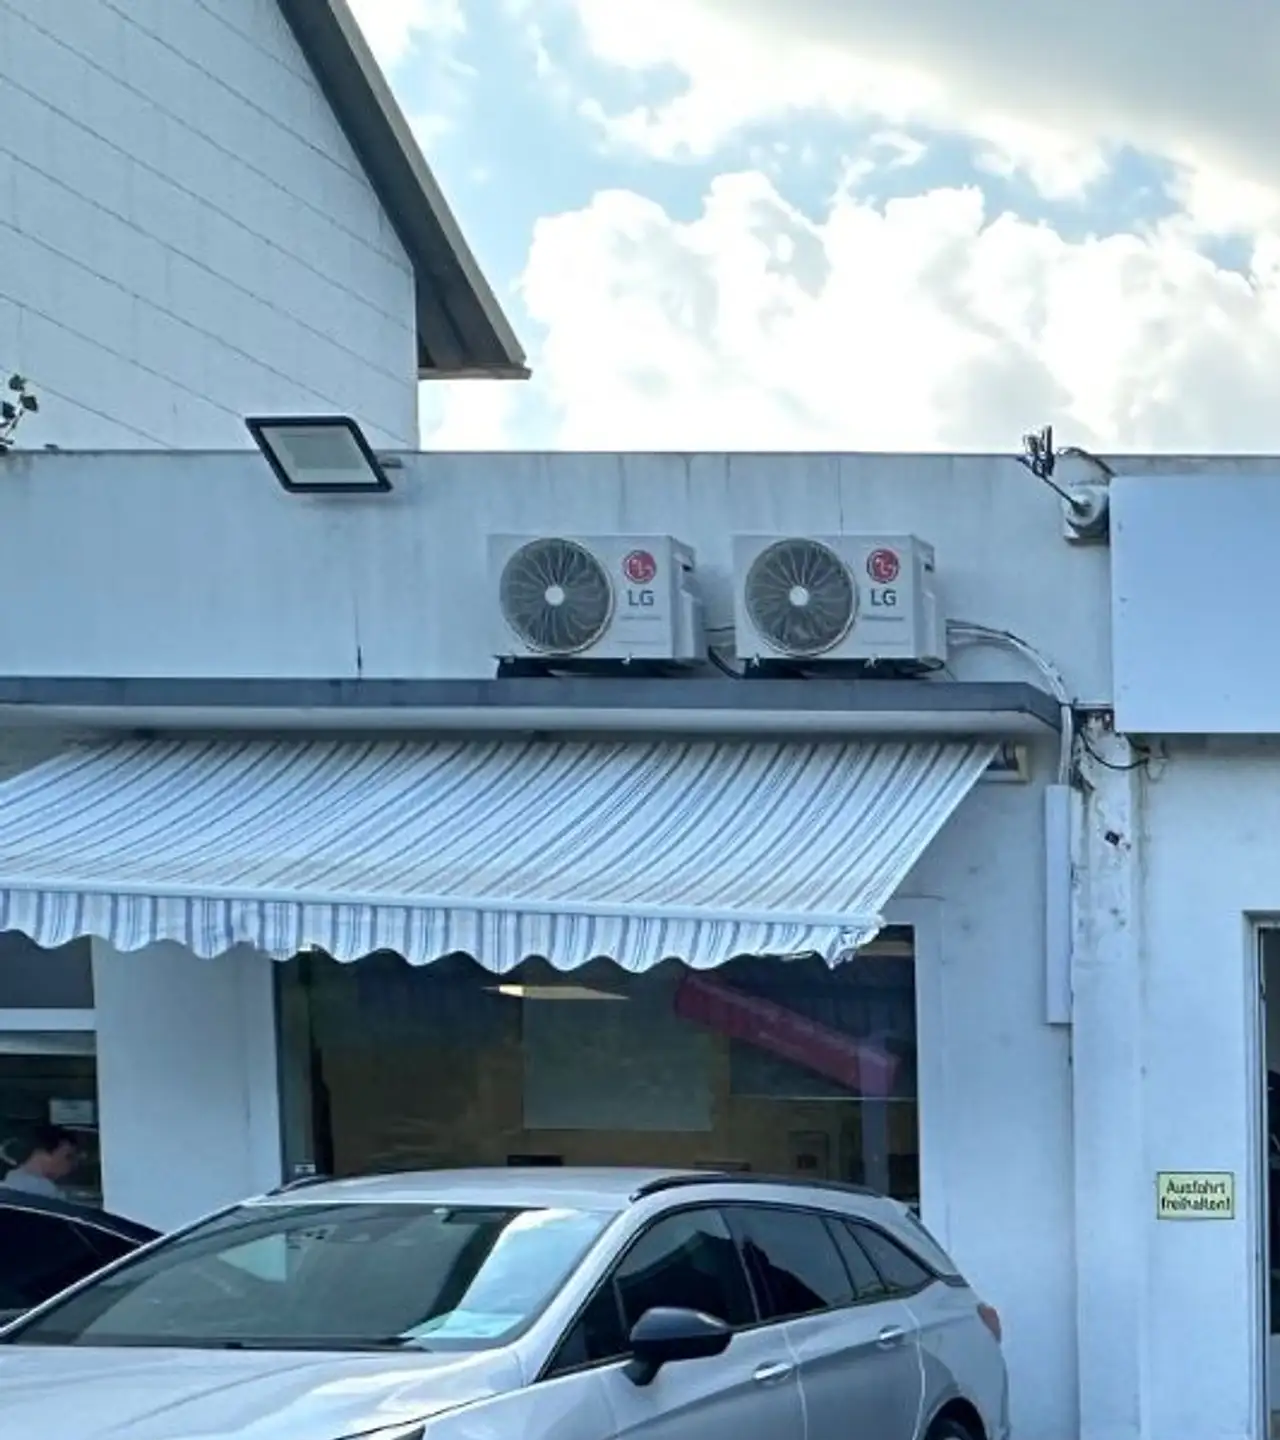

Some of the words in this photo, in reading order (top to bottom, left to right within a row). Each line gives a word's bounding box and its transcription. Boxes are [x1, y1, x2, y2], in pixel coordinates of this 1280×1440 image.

[628, 589, 654, 606] LG
[870, 589, 897, 606] LG
[1166, 1179, 1225, 1194] Ausfahrt
